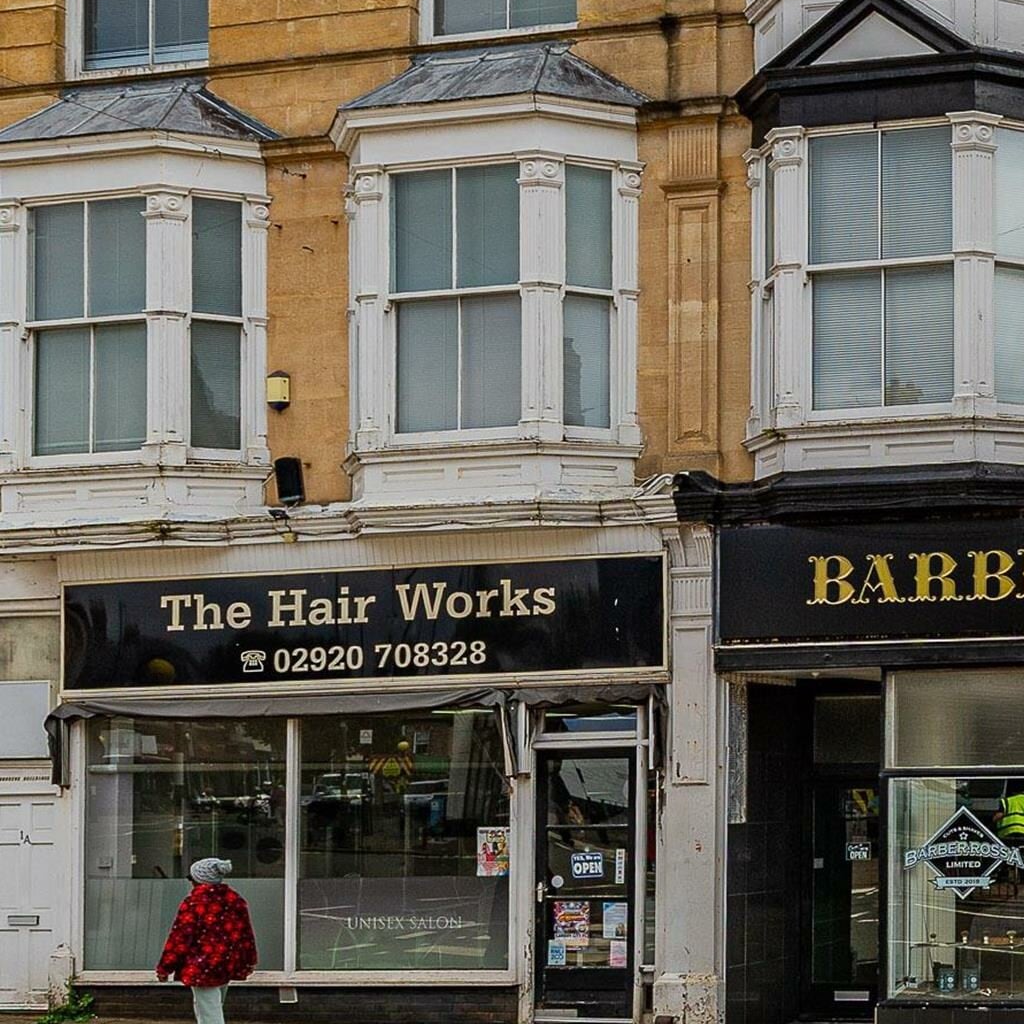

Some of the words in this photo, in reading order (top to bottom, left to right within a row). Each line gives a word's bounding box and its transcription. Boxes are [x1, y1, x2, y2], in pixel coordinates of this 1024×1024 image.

[160, 594, 252, 631] The
[267, 586, 377, 628] Hair
[395, 579, 557, 622] Works
[273, 645, 364, 673] 02920
[374, 640, 487, 669] 708328
[850, 851, 867, 860] OPEN
[575, 862, 602, 875] OPEN
[946, 861, 981, 869] LIMITED
[347, 916, 404, 930] UNISEX
[409, 915, 462, 929] SALON
